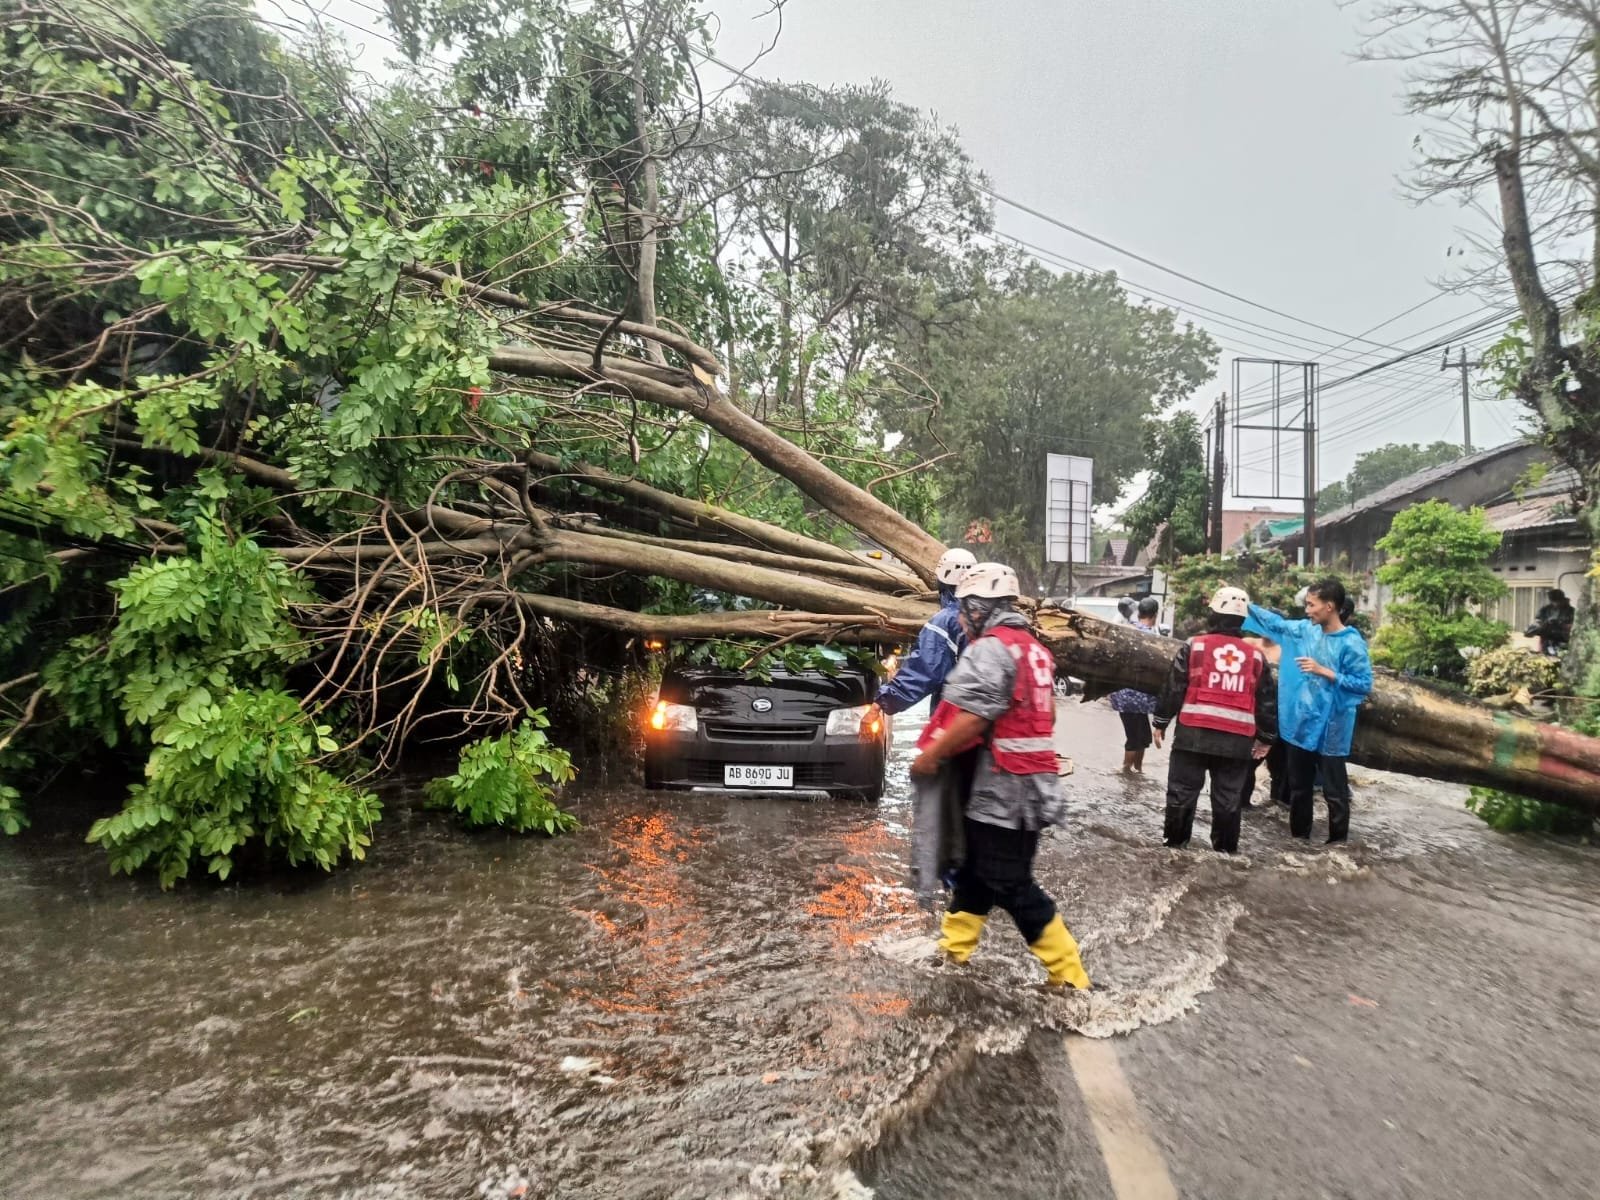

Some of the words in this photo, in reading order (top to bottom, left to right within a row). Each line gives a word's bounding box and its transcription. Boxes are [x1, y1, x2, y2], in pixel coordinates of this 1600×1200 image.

[1208, 671, 1245, 692] PMI
[729, 767, 742, 779] AB
[745, 767, 772, 780] 8690
[776, 768, 790, 780] JU
